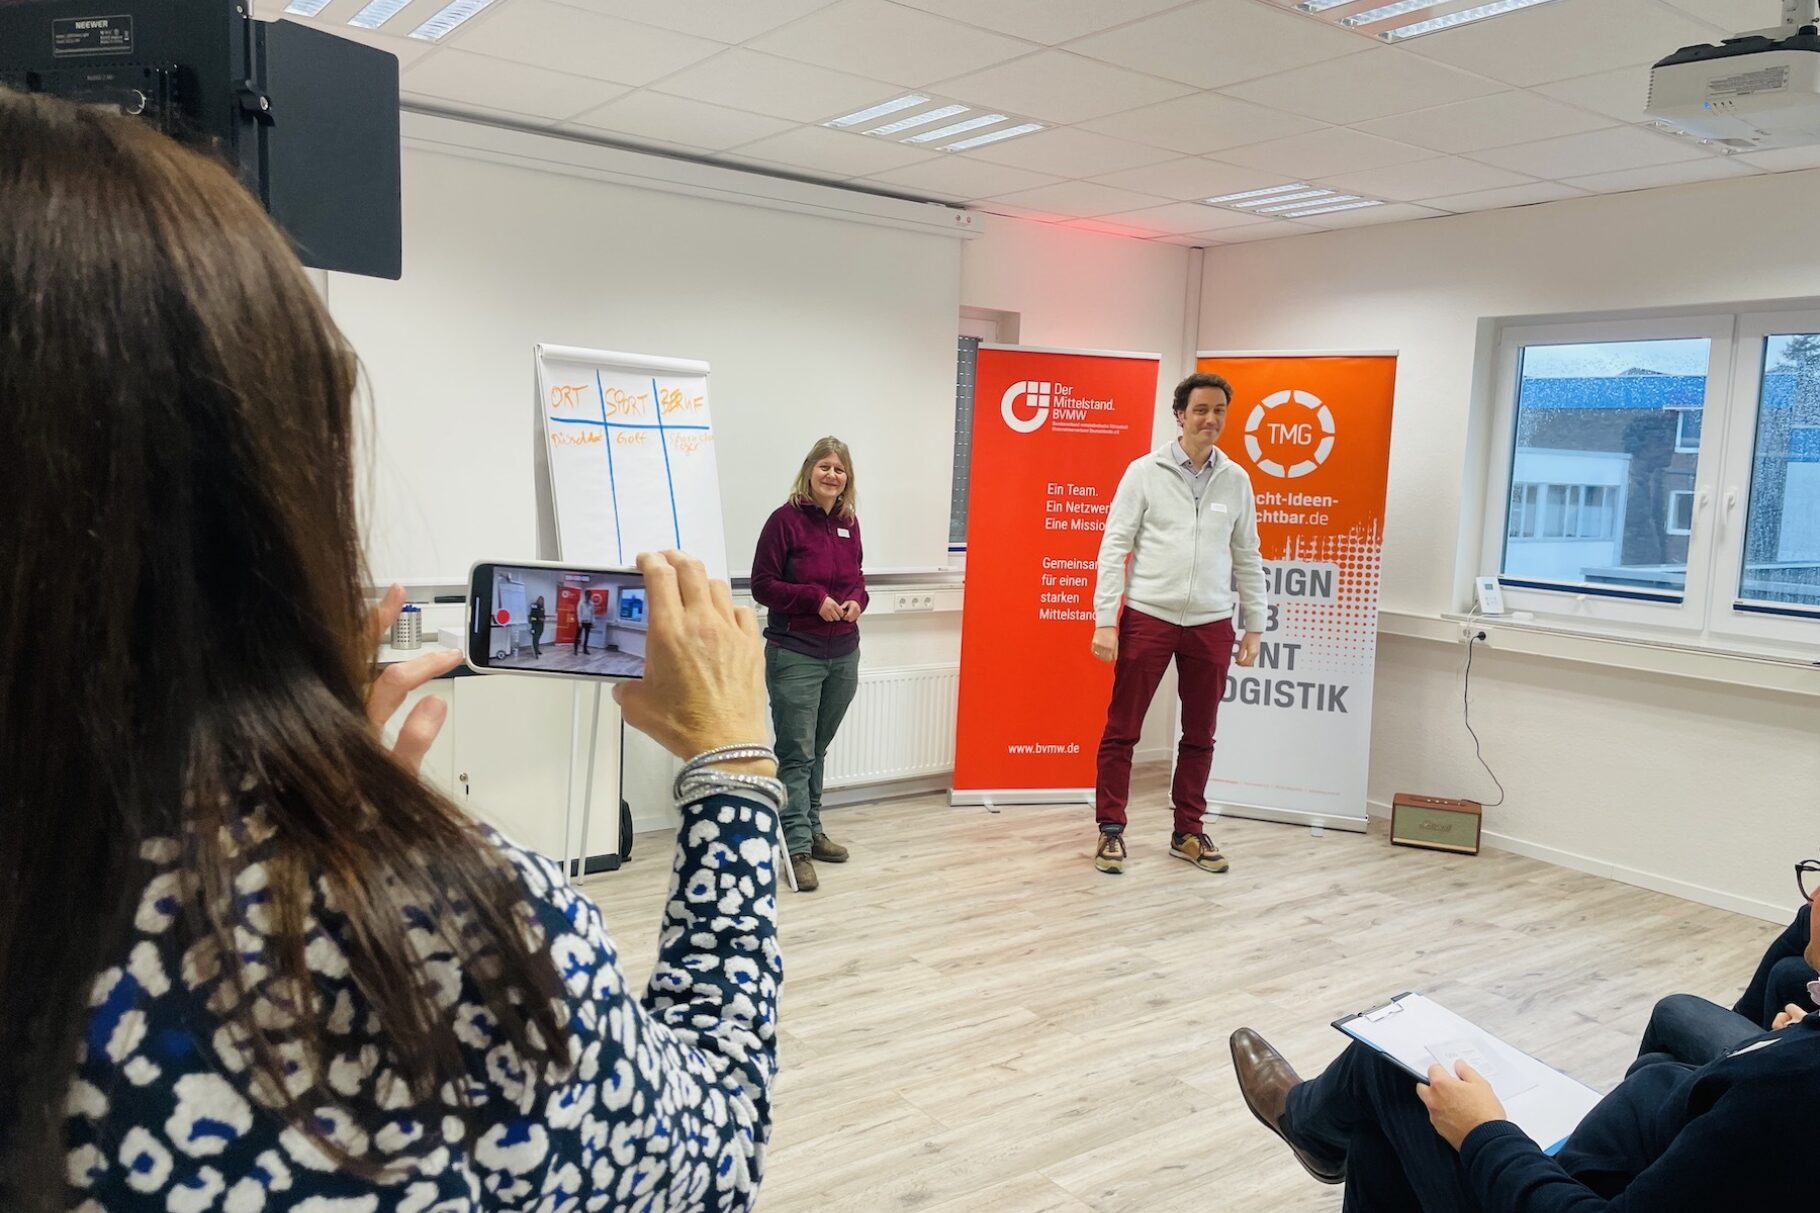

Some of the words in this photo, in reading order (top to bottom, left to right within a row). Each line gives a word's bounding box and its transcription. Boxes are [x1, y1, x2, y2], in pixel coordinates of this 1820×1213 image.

[75, 20, 109, 29] NEEWER
[1054, 382, 1074, 395] Der
[551, 384, 589, 408] ORT
[605, 387, 649, 417] SPORT
[1053, 396, 1116, 411] Mittelstand.
[1052, 409, 1088, 420] BVMW
[1267, 423, 1313, 445] TMG
[1047, 482, 1064, 495] Ein
[1067, 483, 1099, 497] Team.
[1254, 491, 1339, 507] cht-Ideen-
[1046, 500, 1063, 513] Ein
[1065, 501, 1112, 514] Netzwer
[1045, 517, 1068, 530] Eine
[1071, 518, 1105, 531] Missio
[1255, 509, 1329, 526] chtbar.de
[1041, 573, 1057, 586] für
[1059, 575, 1088, 587] einen
[1040, 591, 1080, 604] starken
[1221, 675, 1349, 713] OGISTIK
[1008, 742, 1080, 754] www.bvmw.de
